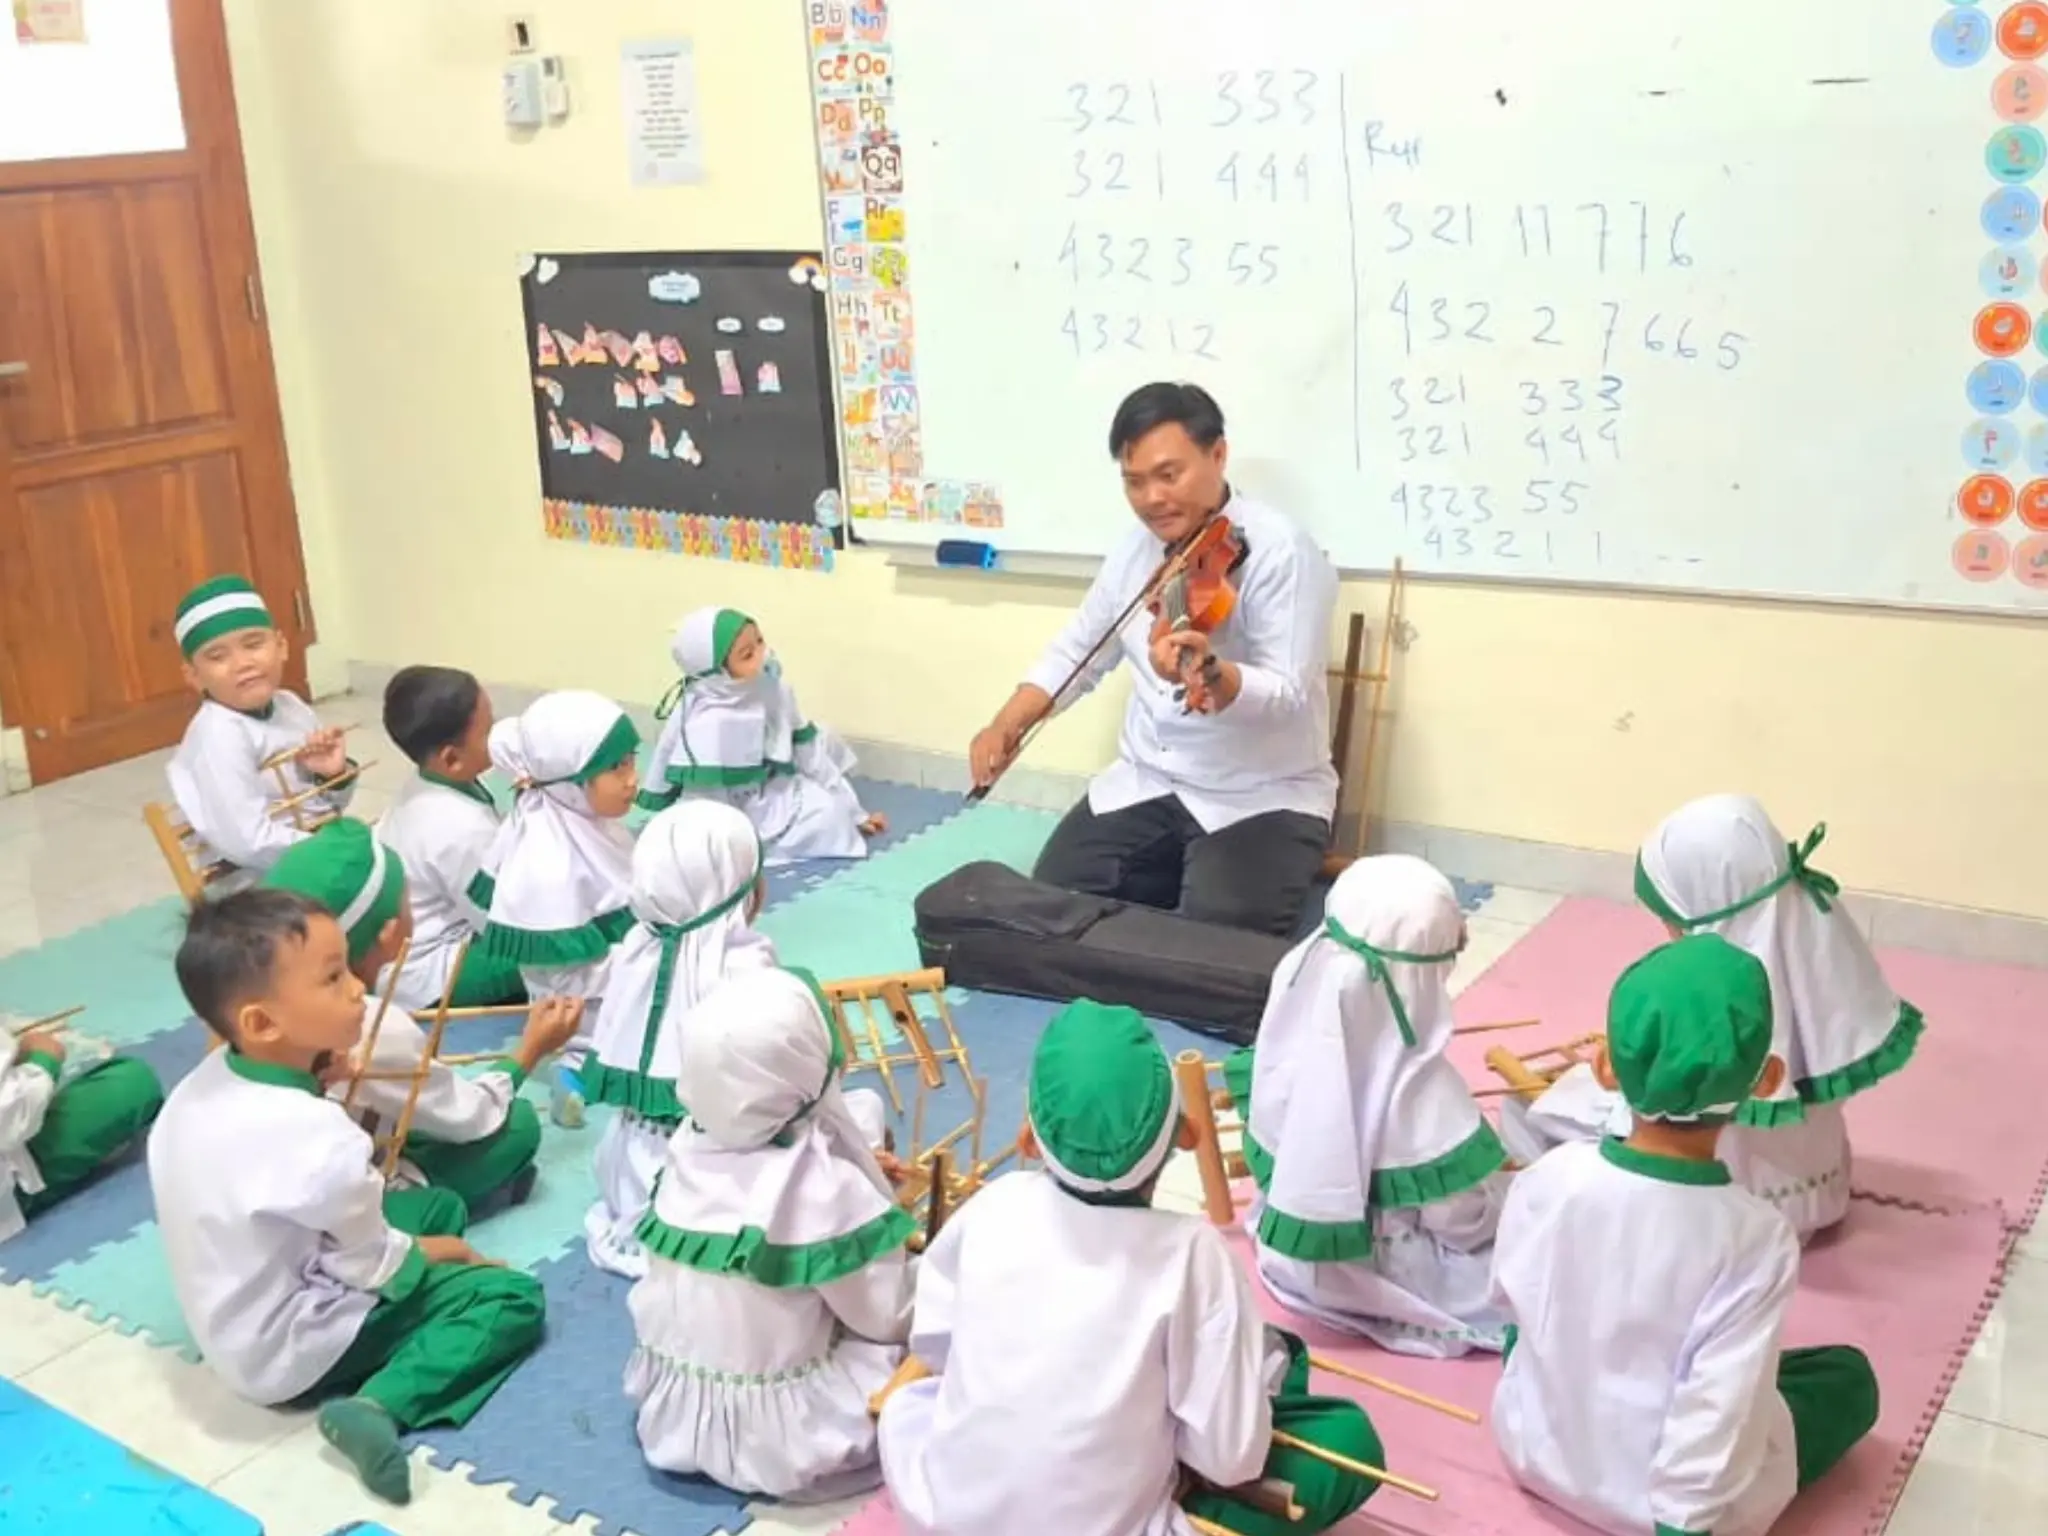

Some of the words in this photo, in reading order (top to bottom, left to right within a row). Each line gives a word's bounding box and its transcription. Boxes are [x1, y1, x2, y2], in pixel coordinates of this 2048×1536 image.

[854, 52, 886, 75] Oo
[1067, 78, 1162, 133] 321
[1209, 68, 1319, 128] 333
[865, 154, 898, 179] Qq
[1065, 147, 1164, 202] 321
[1384, 200, 1475, 254] 321
[1389, 374, 1468, 421] 321
[1518, 374, 1623, 416] 333
[1396, 421, 1470, 462] 321
